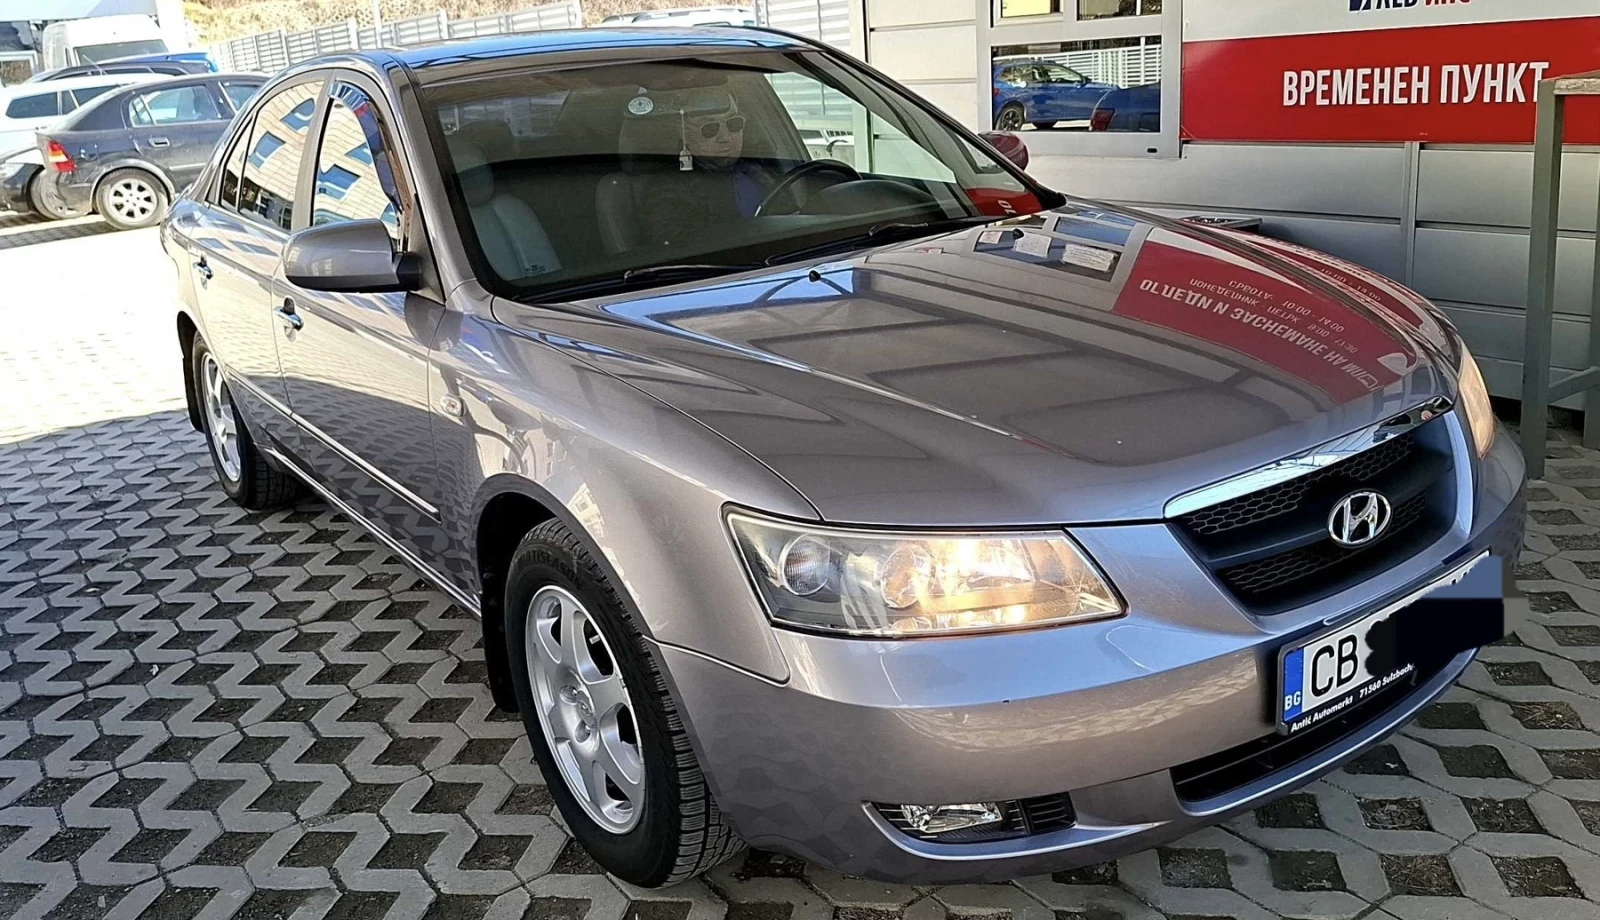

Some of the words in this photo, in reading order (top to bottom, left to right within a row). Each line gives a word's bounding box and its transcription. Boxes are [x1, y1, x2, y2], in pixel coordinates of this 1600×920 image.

[1283, 66, 1430, 106] ВРЕМЕНЕН
[1440, 61, 1549, 104] ПУНКТ
[1284, 690, 1301, 711] BG
[1312, 695, 1354, 723] Automarkt
[1359, 680, 1382, 699] 71560
